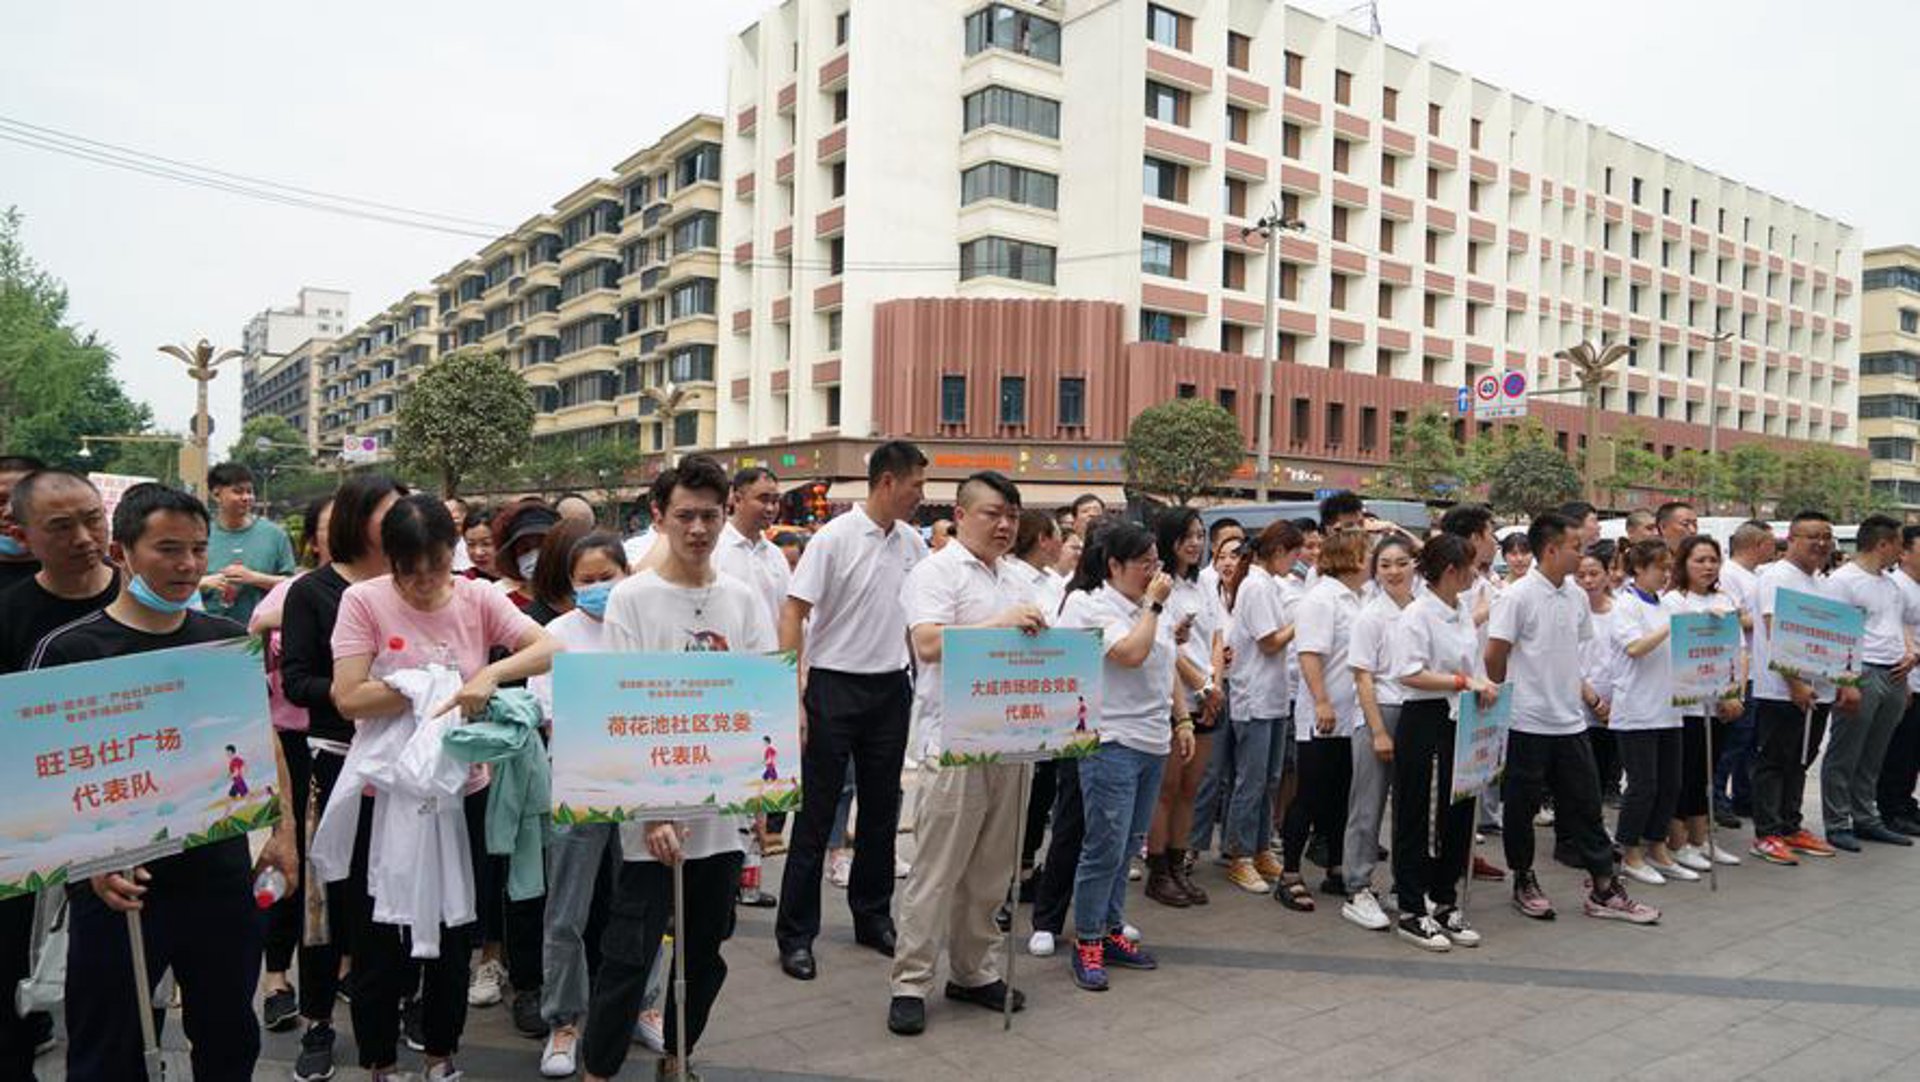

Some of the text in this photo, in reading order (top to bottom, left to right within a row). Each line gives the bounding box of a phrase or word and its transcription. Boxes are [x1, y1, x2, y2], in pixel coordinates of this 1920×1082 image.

[607, 712, 752, 737] 荷花池社区党委
[1005, 704, 1046, 721] 代表队
[34, 727, 182, 778] 旺马仕广场
[650, 744, 712, 767] 代表队
[71, 770, 159, 812] 代表队
